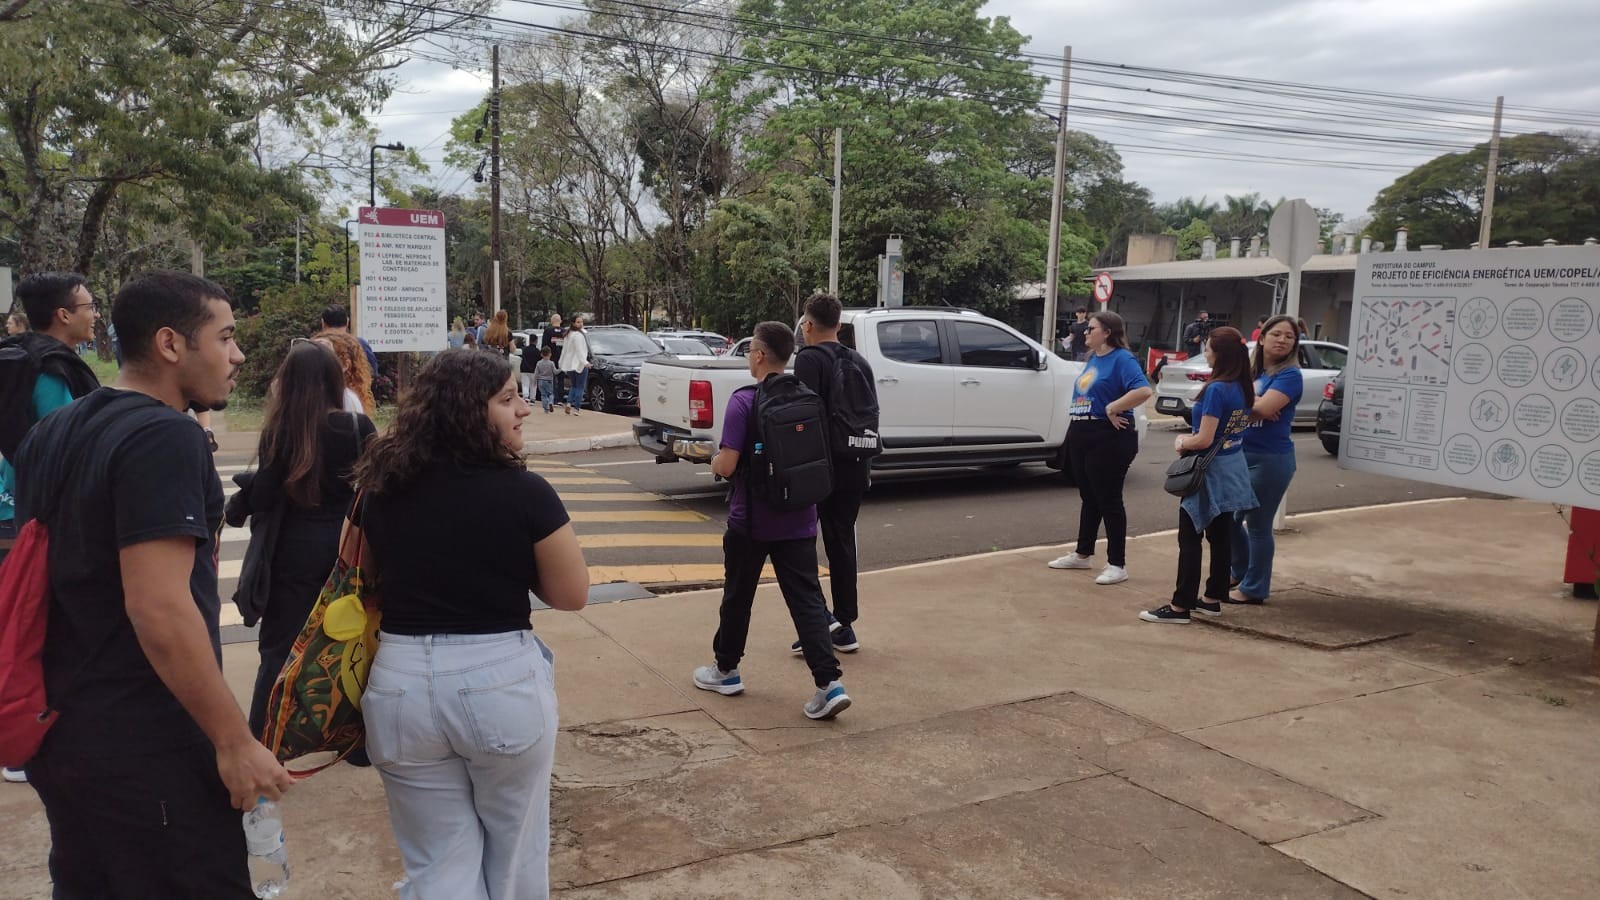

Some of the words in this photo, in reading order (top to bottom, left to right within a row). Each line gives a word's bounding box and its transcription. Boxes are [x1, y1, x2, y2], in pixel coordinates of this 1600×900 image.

[410, 214, 438, 224] UEM
[1372, 270, 1407, 280] PROJETO
[1410, 270, 1420, 279] DE
[1422, 268, 1470, 279] EFICIÊNCIA
[1473, 267, 1530, 279] ENERGÉTICA
[848, 436, 877, 448] PUMA
